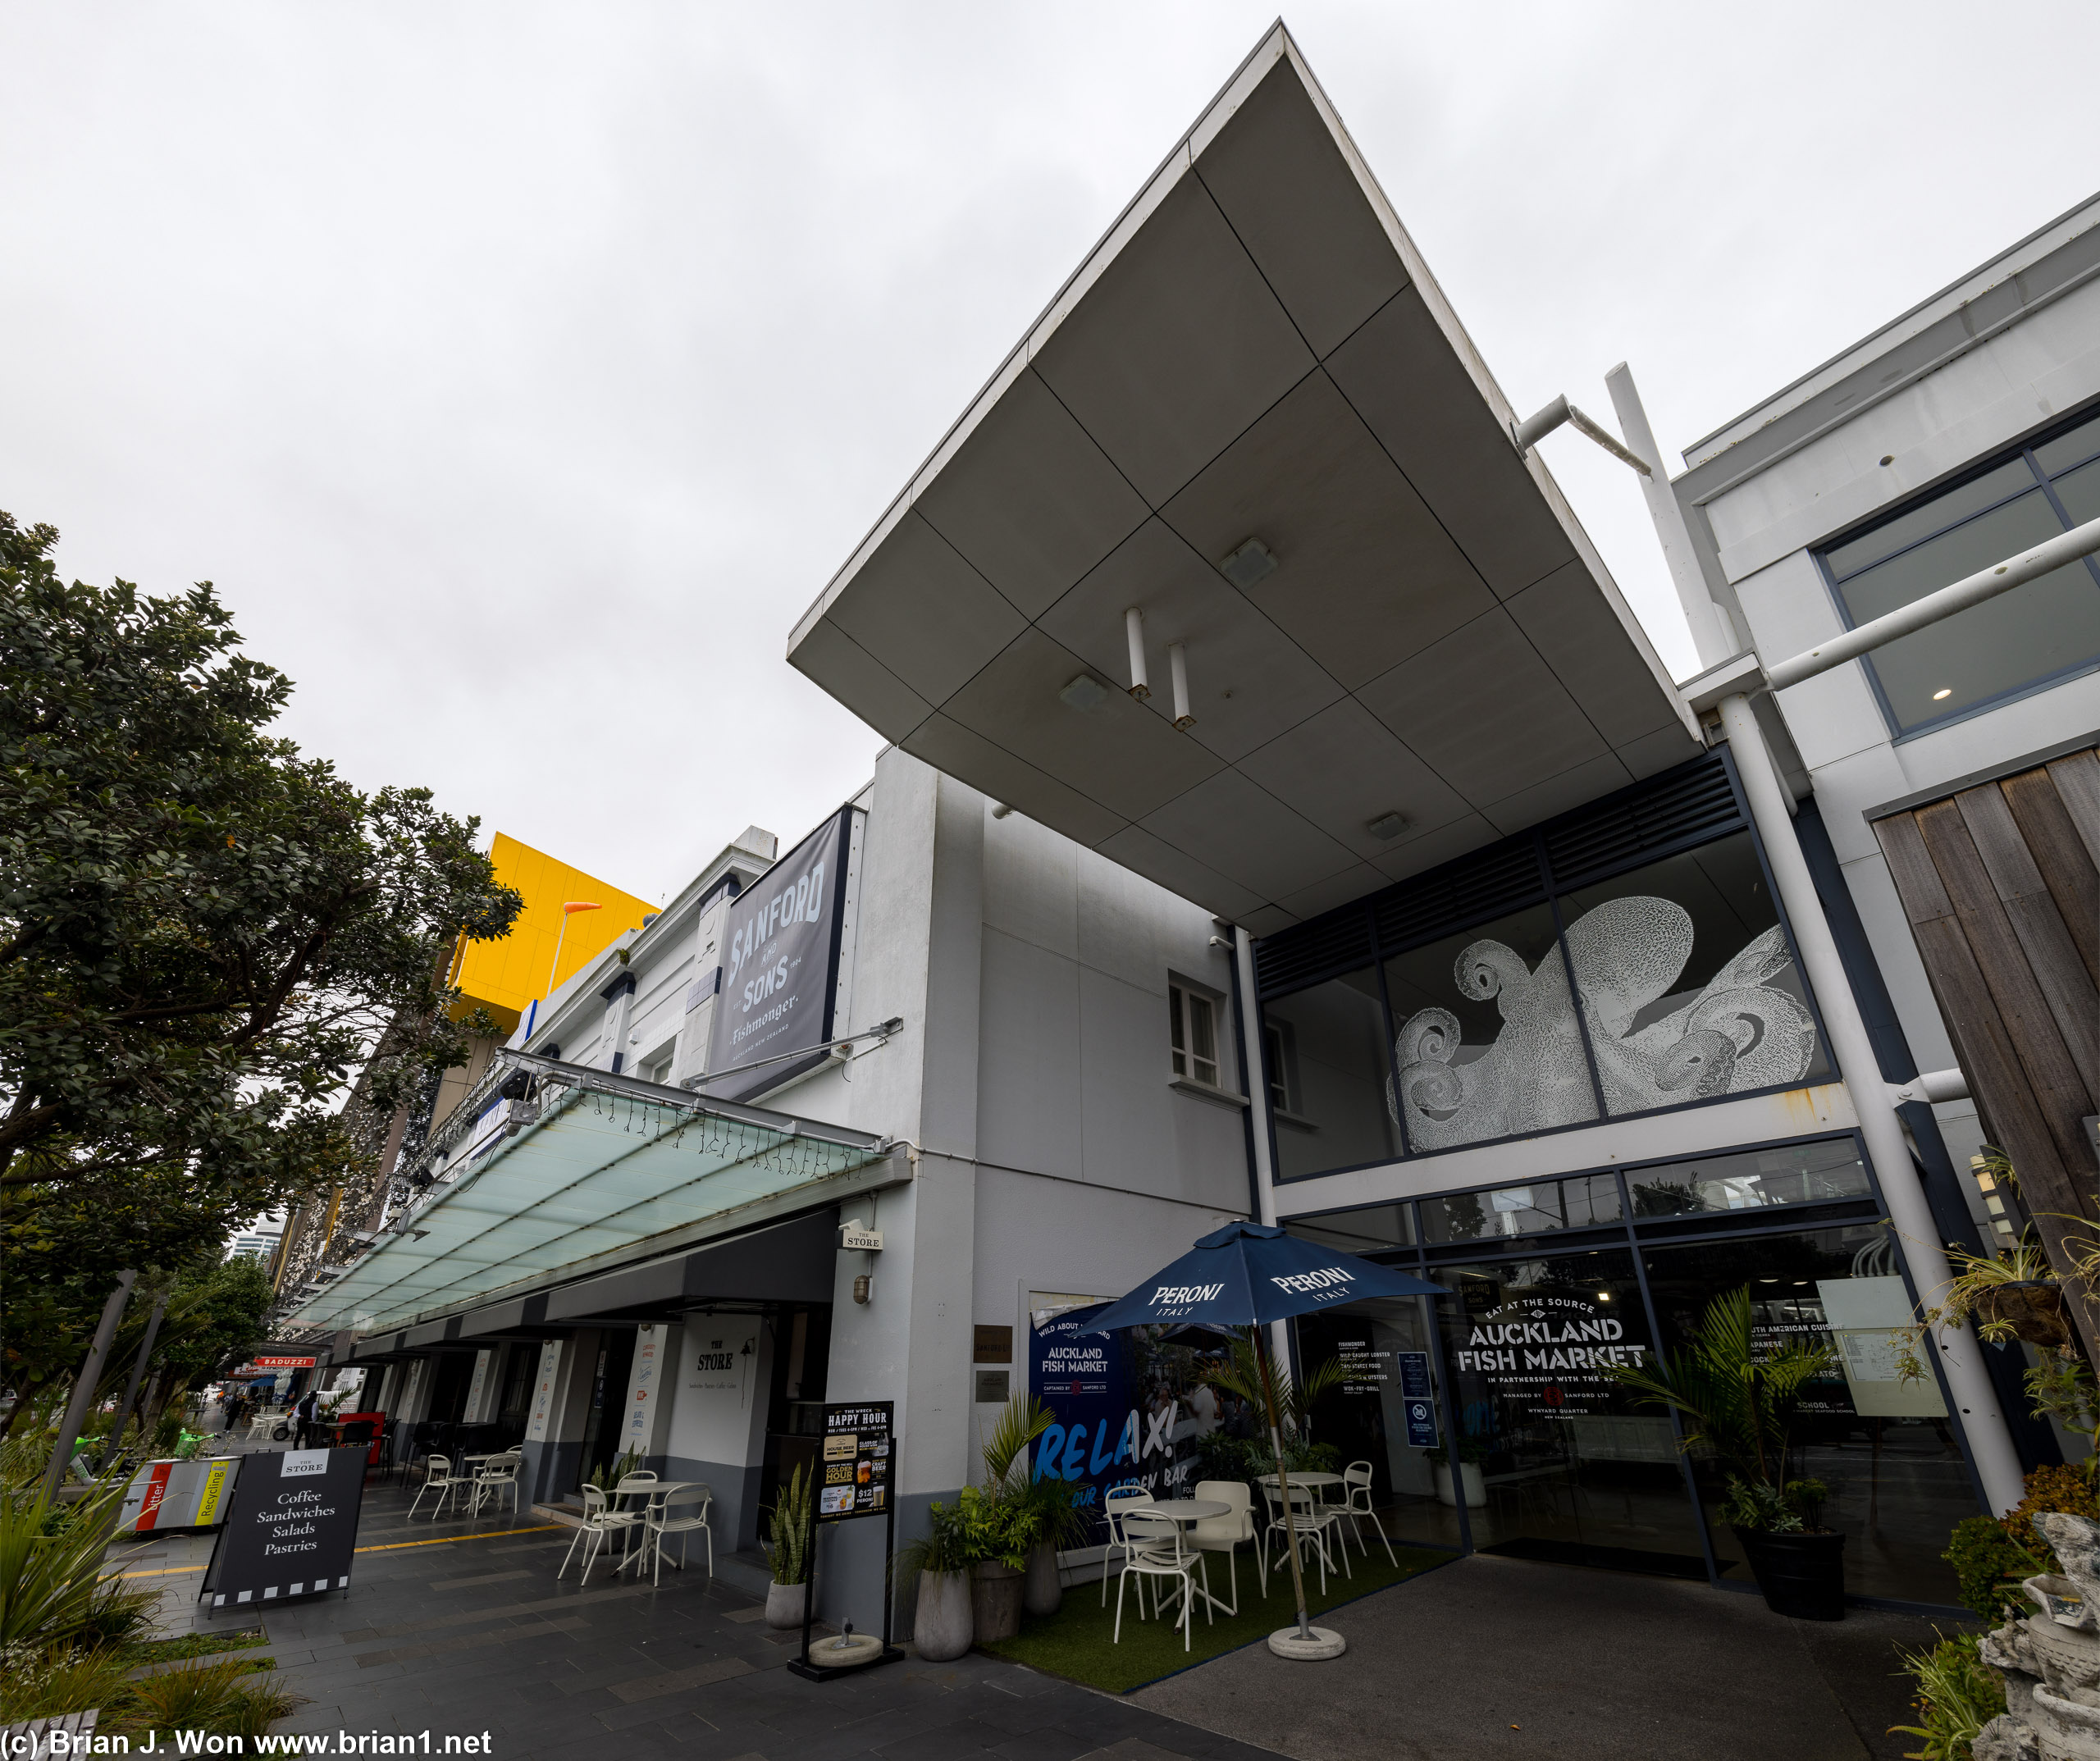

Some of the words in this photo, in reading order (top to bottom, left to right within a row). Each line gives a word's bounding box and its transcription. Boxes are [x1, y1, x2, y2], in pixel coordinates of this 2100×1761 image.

[728, 861, 824, 988] SANFORD
[761, 943, 777, 965] AND
[742, 956, 788, 1012] SONS
[766, 1024, 789, 1041] ZEALAND
[847, 1238, 879, 1247] STORE
[1270, 1267, 1356, 1294] PERONI
[1148, 1284, 1225, 1306] PERONI
[1312, 1287, 1350, 1302] ITALY
[1156, 1307, 1194, 1316] ITALY
[1486, 1305, 1503, 1319] EAT
[1507, 1301, 1518, 1311] AT
[1522, 1298, 1543, 1307] THE
[1548, 1298, 1595, 1313] SOURCE
[1039, 1325, 1055, 1338] WILD
[1470, 1319, 1623, 1346] AUCKLAND
[1751, 1325, 1766, 1334] UTH
[711, 1341, 723, 1349] THE
[1048, 1348, 1102, 1359] AUCKLAND
[697, 1353, 733, 1371] STORE
[1043, 1361, 1065, 1372] FISH
[1068, 1361, 1108, 1372] MARKET
[1458, 1349, 1517, 1371] FISH
[1524, 1345, 1646, 1370] MARKET
[828, 1414, 859, 1426] HAPPY
[862, 1412, 887, 1424] HOUR
[1032, 1400, 1178, 1485] RELAX!
[285, 1463, 323, 1473] STORE
[826, 1471, 852, 1480] HOUR
[201, 1471, 225, 1517] Recycling
[858, 1490, 872, 1498] $12
[1071, 1486, 1097, 1508] OUR
[1164, 1465, 1188, 1487] BAR
[1182, 1485, 1195, 1494] FOLL
[148, 1485, 164, 1511] Litter
[277, 1490, 322, 1504] Coffee
[257, 1504, 336, 1523] Sandwiches
[272, 1521, 316, 1538] Salads
[264, 1540, 317, 1555] Pastries
